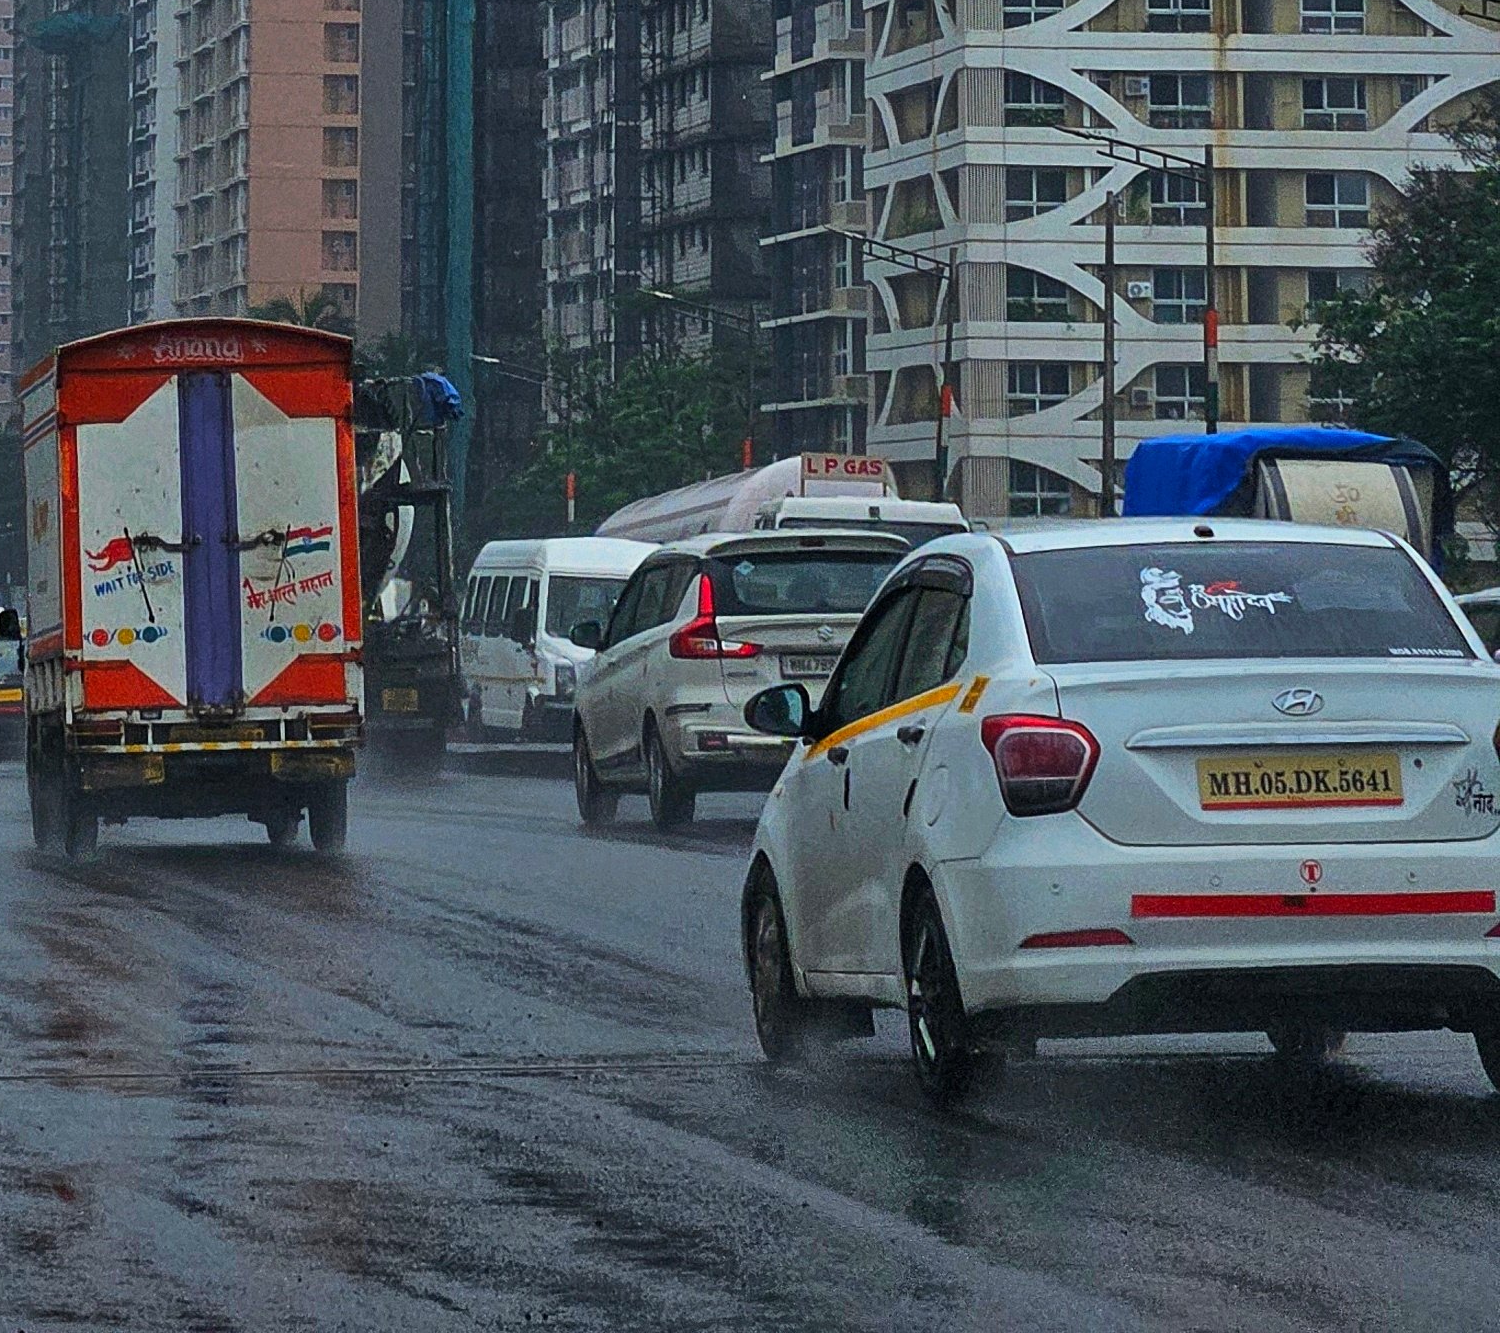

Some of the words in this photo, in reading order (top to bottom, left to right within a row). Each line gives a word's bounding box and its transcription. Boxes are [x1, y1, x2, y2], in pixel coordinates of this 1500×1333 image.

[152, 335, 243, 363] Anand
[844, 459, 883, 475] GAS
[94, 576, 125, 597] WAIT
[127, 572, 145, 587] FOR
[147, 561, 175, 580] SIDE
[1208, 768, 1394, 797] MH.05.DK.5641
